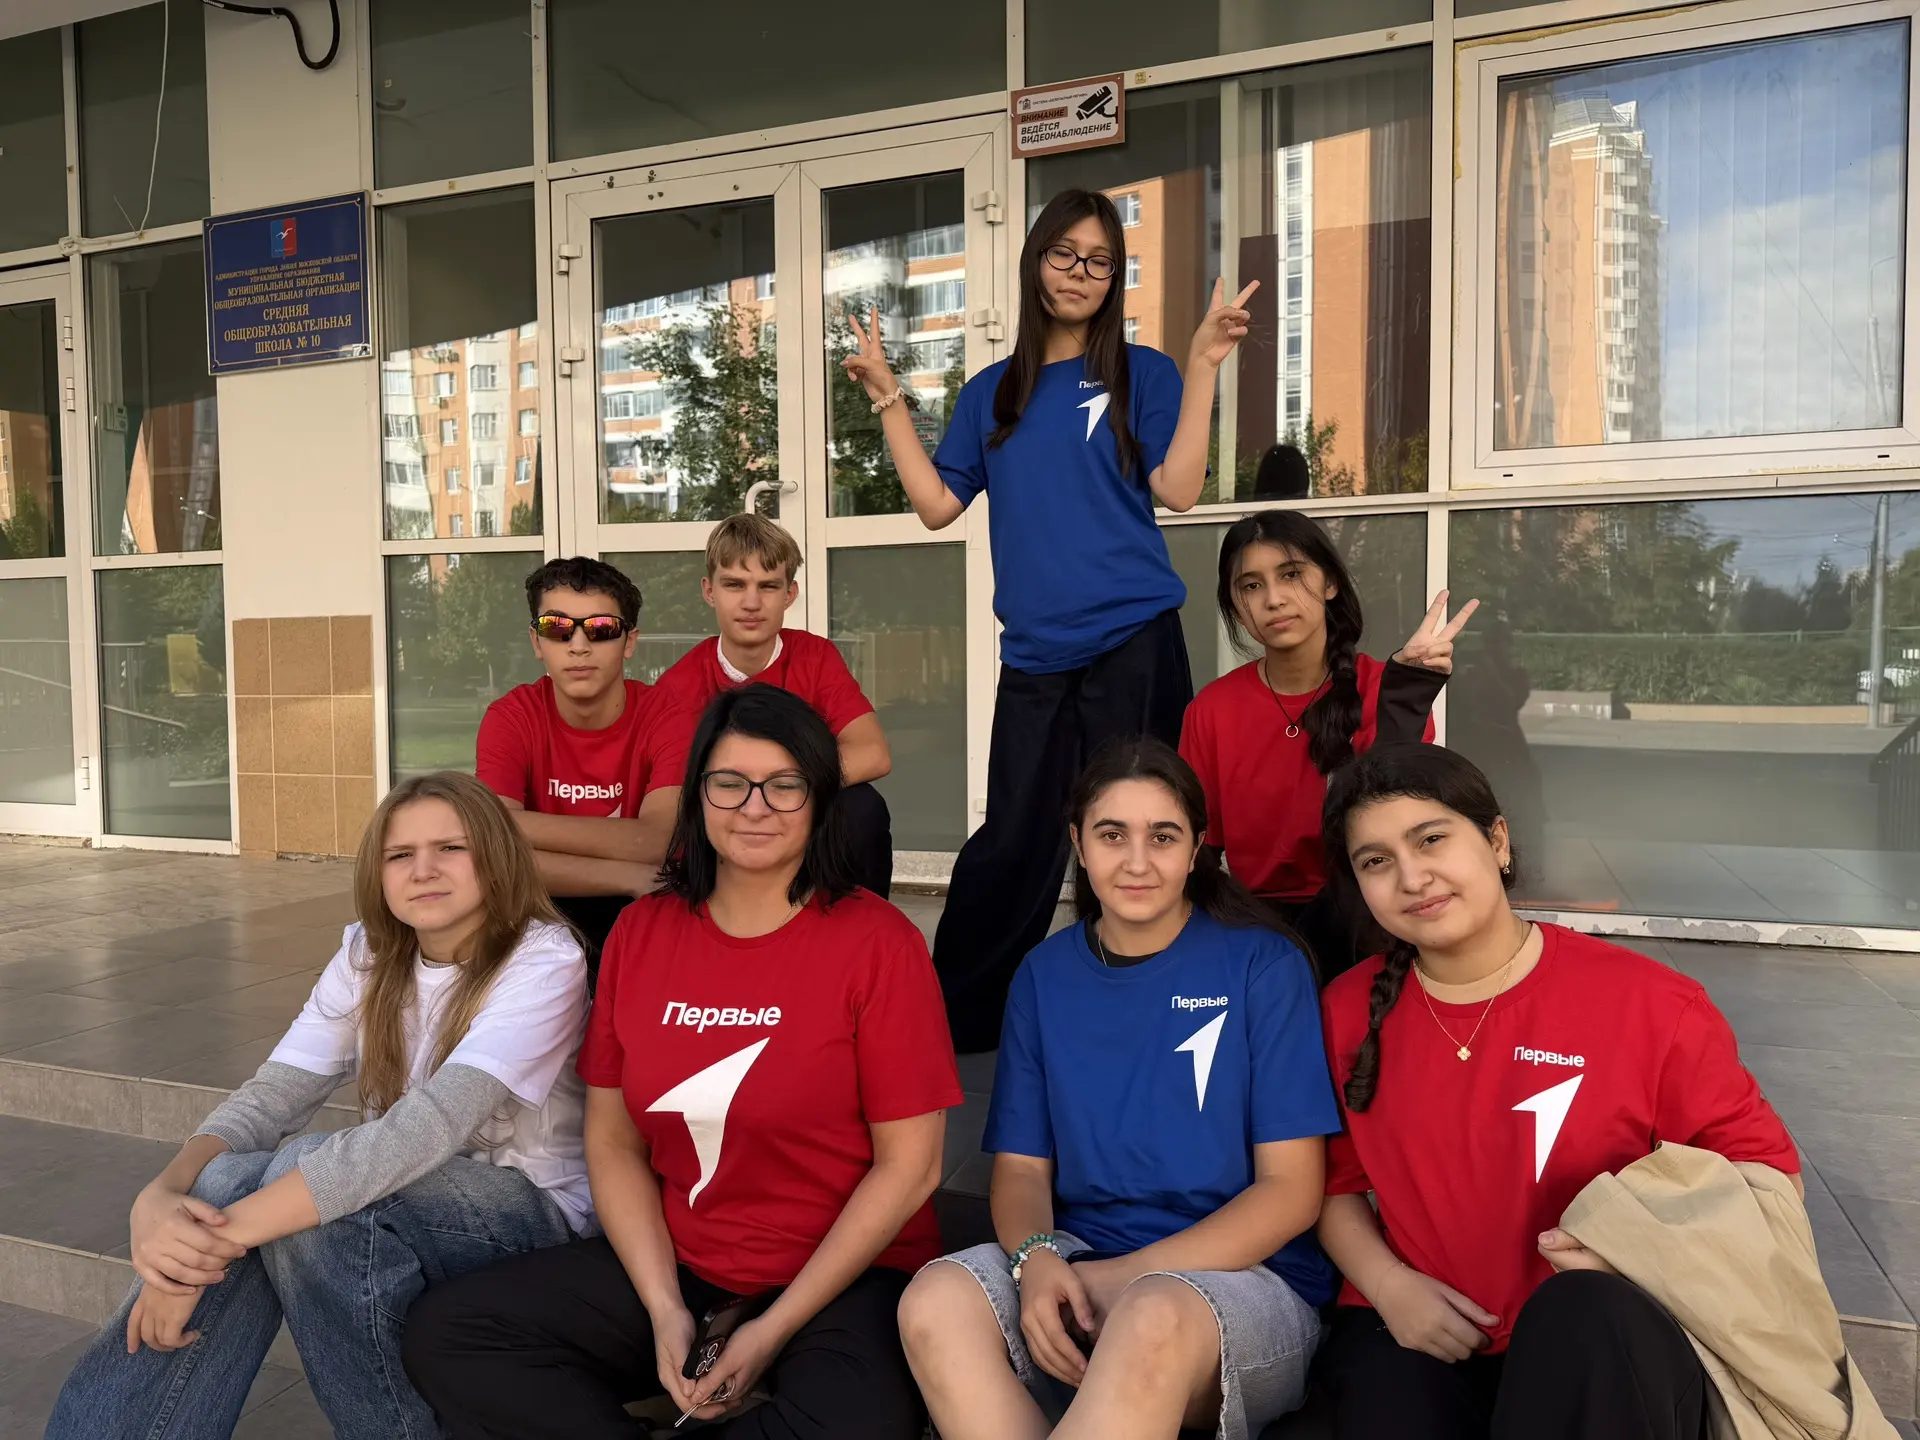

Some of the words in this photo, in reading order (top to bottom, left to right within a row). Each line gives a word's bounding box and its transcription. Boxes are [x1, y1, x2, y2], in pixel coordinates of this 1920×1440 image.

[1021, 109, 1065, 122] ВНИМАНИЕ
[1021, 122, 1060, 135] ВЕДЁТСЯ
[1021, 123, 1112, 144] ВИДЕОНАБЛЮДЕНИЕ
[215, 268, 259, 280] АДМИНИСТРАЦИЯ
[260, 265, 279, 274] ГОРОДА
[299, 257, 333, 267] МОСКОВСКОЙ
[333, 254, 358, 263] ОБЛАСТИ
[284, 267, 321, 279] ОБРАЗОВАНИЯ
[228, 280, 294, 297] МУНИЦИПАЛЬНАЯ
[296, 272, 345, 287] БЮДЖЕТНАЯ
[214, 290, 304, 310] ОБЩЕОБРАЗОВАТЕЛЬНАЯ
[305, 281, 361, 298] ОРГАНИЗАЦИЯ
[263, 303, 309, 321] СРЕДНЯЯ
[224, 314, 352, 342] ОБЩЕОБРАЗОВАТЕЛЬНАЯ
[255, 338, 292, 354] ШКОЛА
[296, 337, 307, 348] №
[311, 334, 321, 347] 10
[1079, 380, 1104, 389] Перв
[548, 778, 623, 804] Первые
[1171, 996, 1228, 1012] Первые
[661, 1001, 781, 1033] Первые
[1514, 1046, 1585, 1067] Первые
